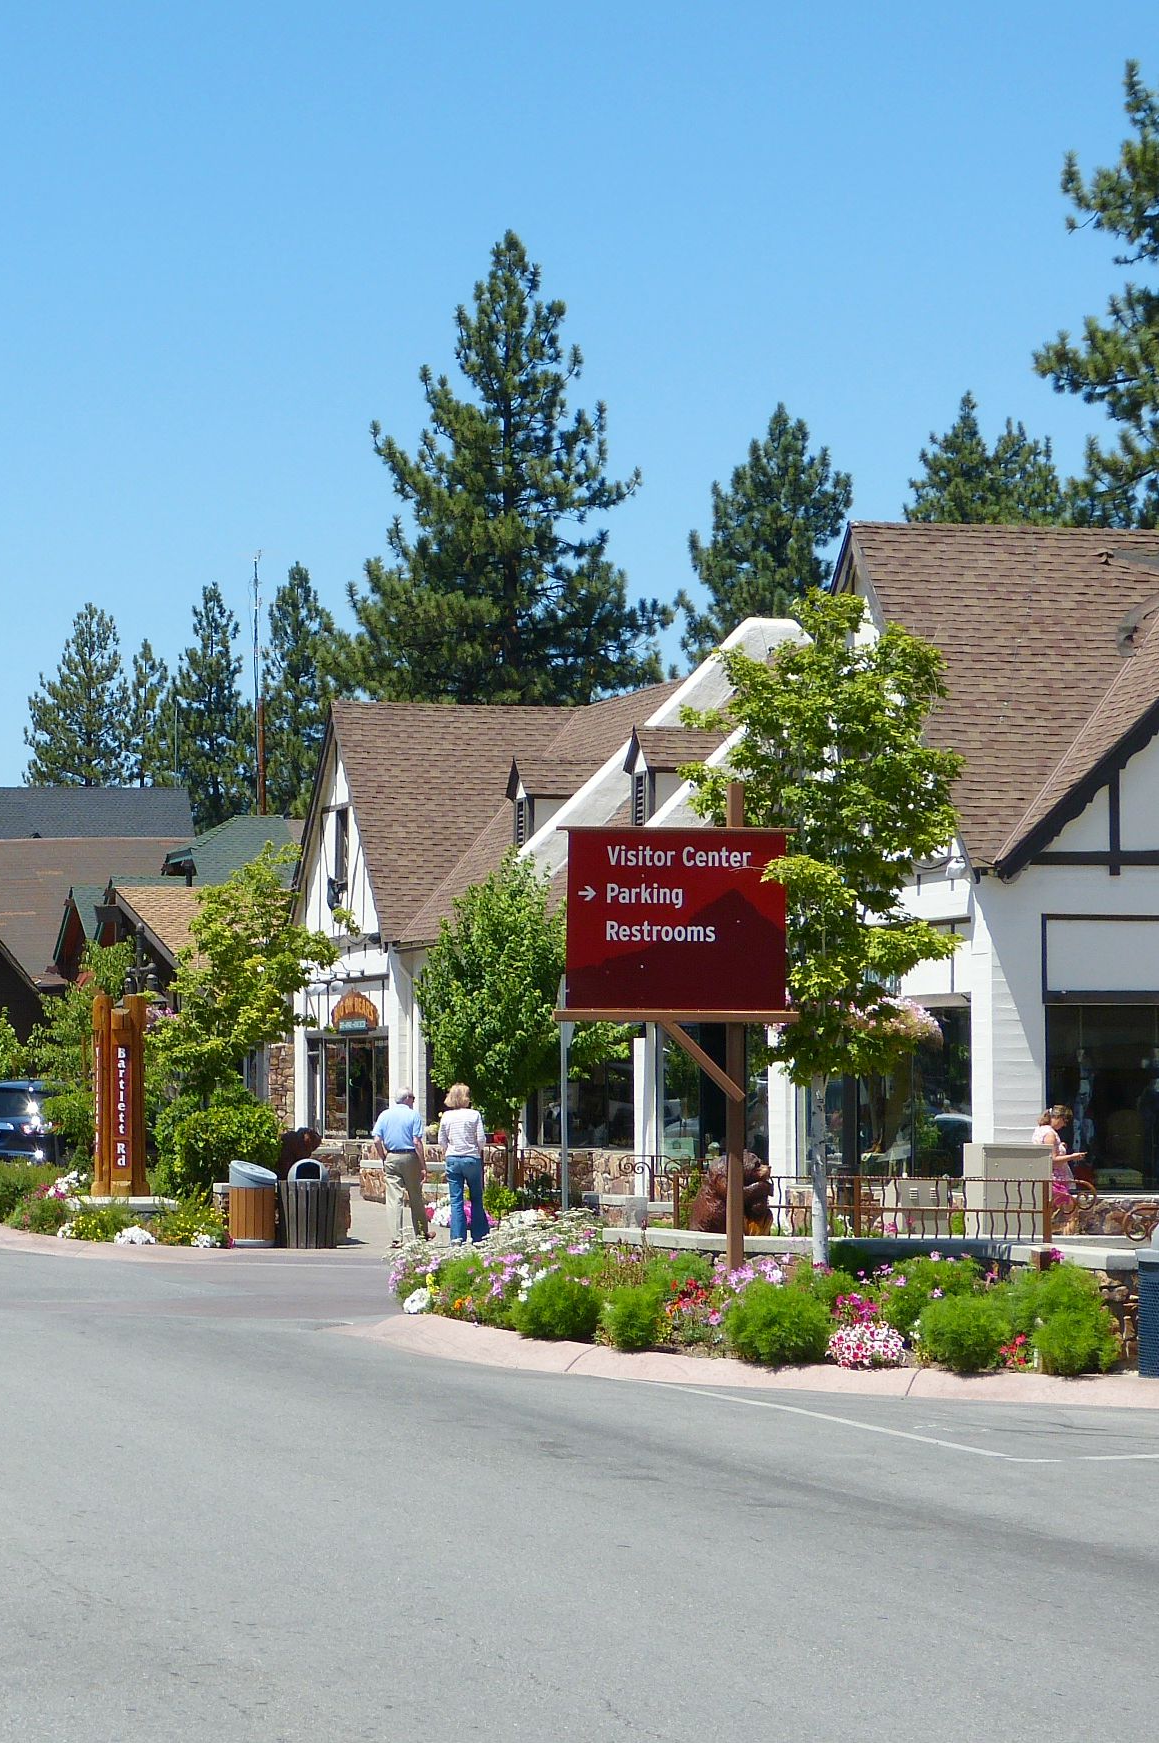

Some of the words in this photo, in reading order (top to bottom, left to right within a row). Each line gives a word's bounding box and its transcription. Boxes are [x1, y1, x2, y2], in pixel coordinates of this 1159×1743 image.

[607, 845, 676, 867] Visitor
[681, 846, 752, 867] Center
[606, 883, 683, 909] Parking
[605, 920, 716, 942] Restrooms
[117, 1047, 126, 1135] Bartlett
[117, 1142, 126, 1166] Rd
